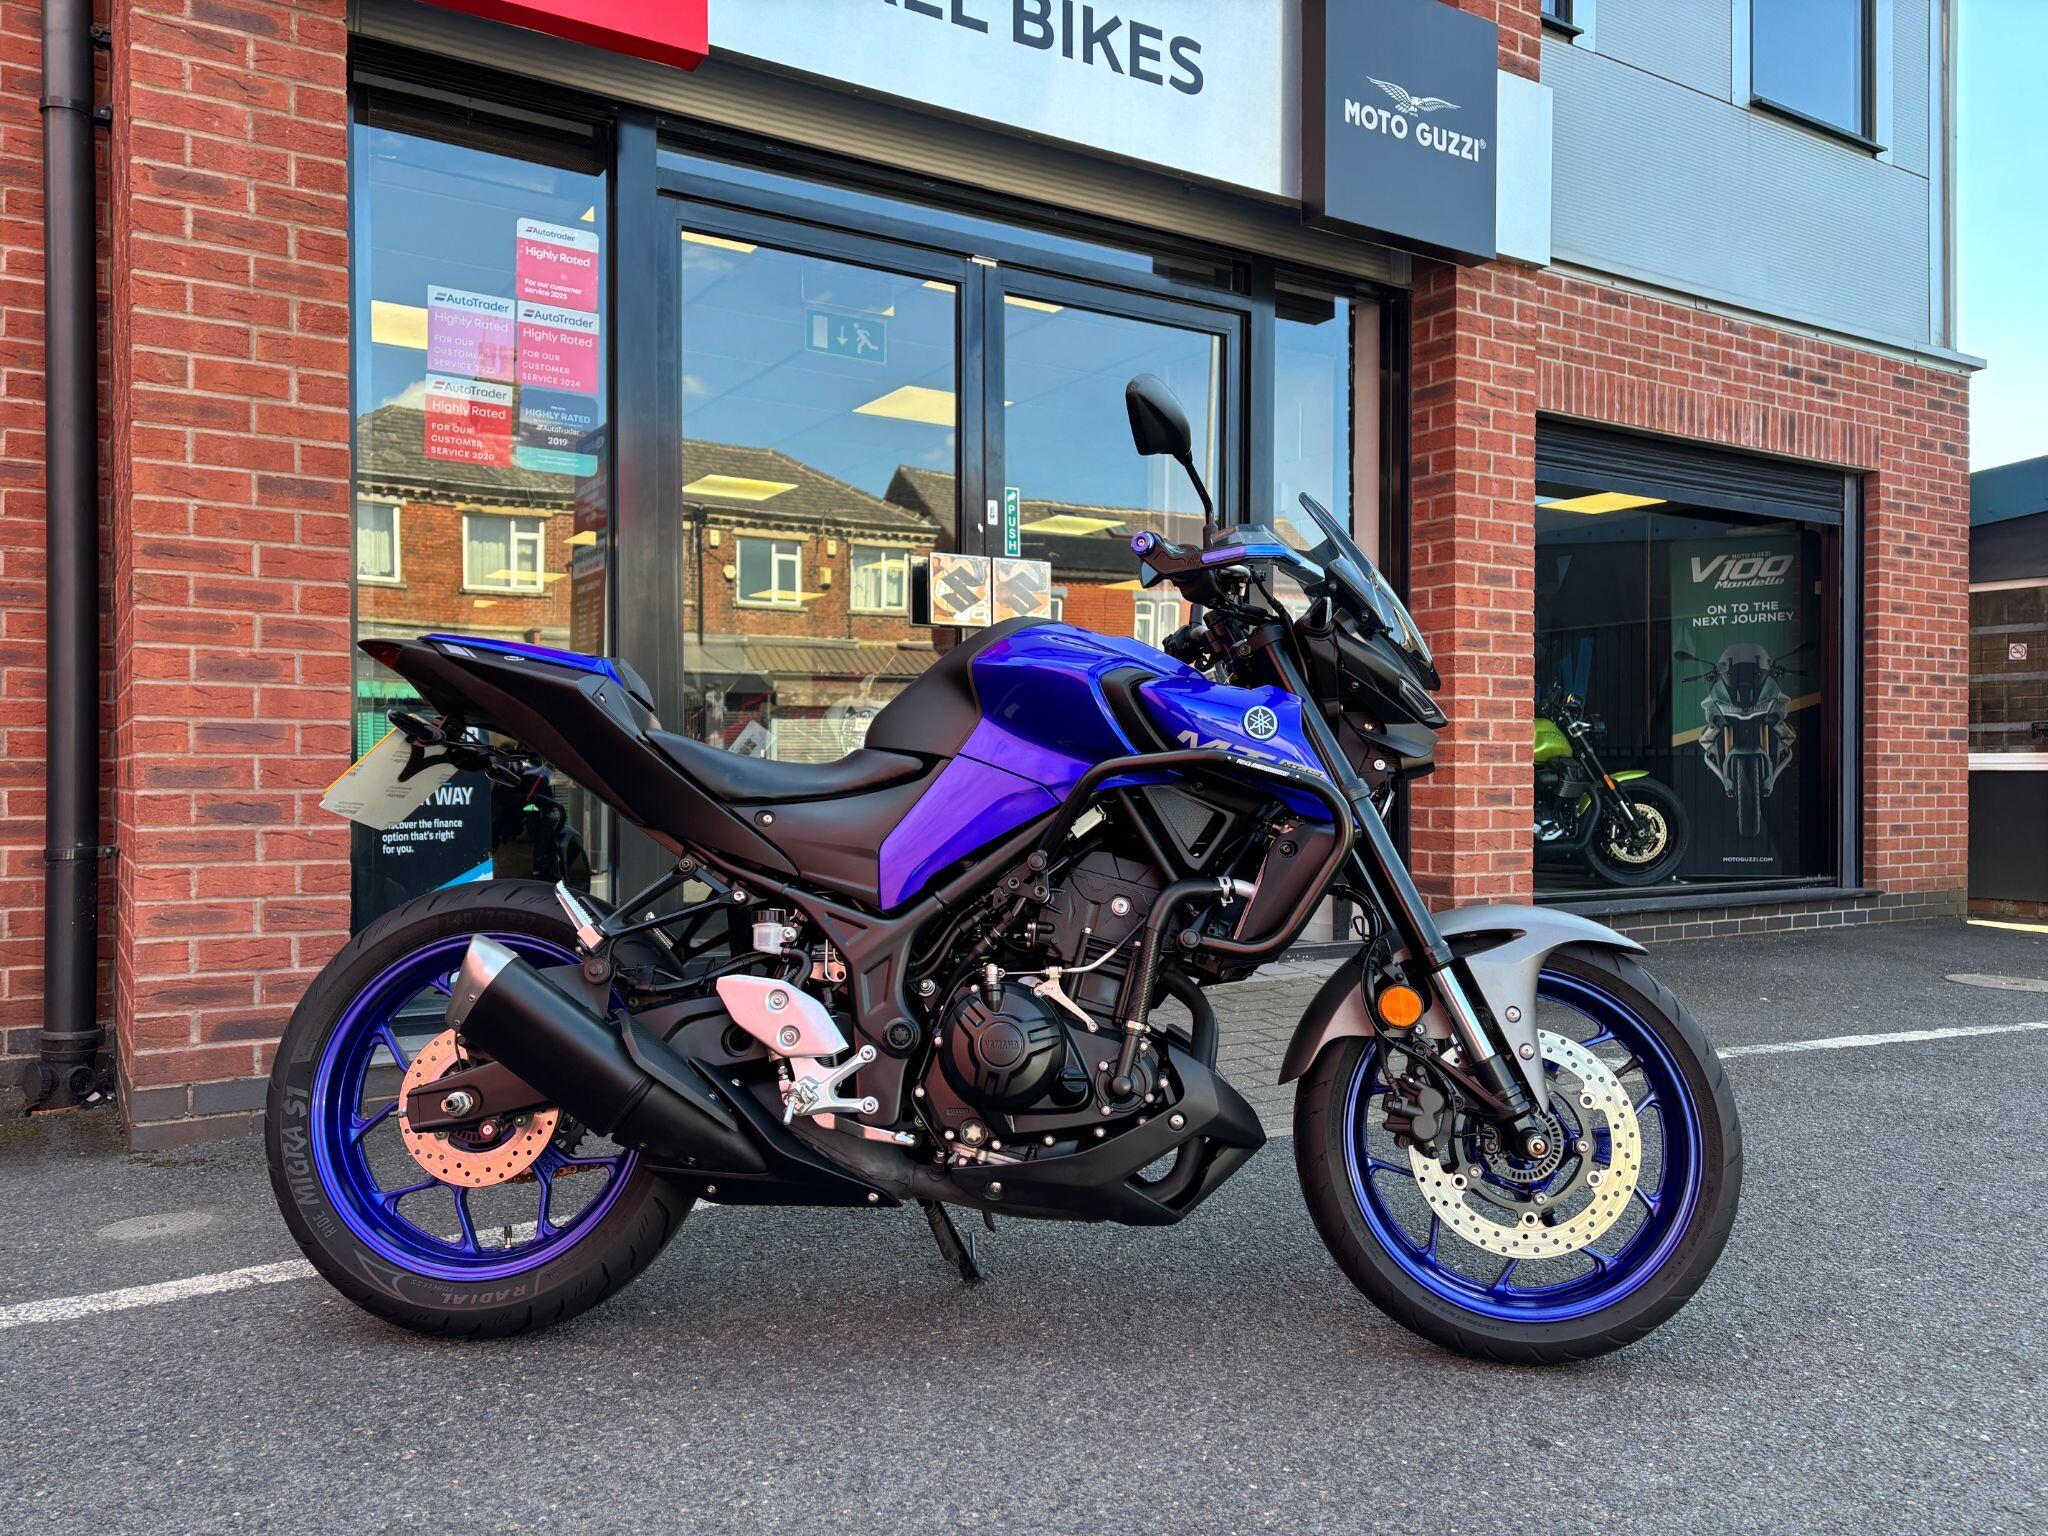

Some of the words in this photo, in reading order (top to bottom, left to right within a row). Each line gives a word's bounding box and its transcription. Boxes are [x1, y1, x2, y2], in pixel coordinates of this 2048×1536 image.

[1012, 0, 1204, 95] BIKES
[1344, 98, 1408, 139] MOTO
[533, 227, 576, 242] Autotrader
[525, 246, 558, 263] Highly
[560, 253, 591, 267] Rated
[524, 278, 537, 287] For
[537, 281, 550, 290] our
[550, 284, 582, 296] customer
[524, 287, 550, 298] service
[446, 294, 510, 313] AutoTrader
[434, 311, 472, 329] Highly
[474, 318, 509, 333] Rated
[534, 310, 594, 329] AutoTrader
[434, 334, 452, 344] FOR
[454, 337, 474, 346] OUR
[523, 327, 558, 344] Highly
[560, 333, 593, 348] Rated
[433, 347, 485, 361] CUSTOMER
[522, 349, 540, 359] FOR
[541, 352, 561, 362] OUR
[433, 358, 472, 371] SERVICE
[522, 361, 570, 375] CUSTOMER
[521, 372, 559, 384] SERVICE
[560, 378, 581, 388] 2024
[444, 383, 508, 400] AutoTrader
[432, 399, 470, 417] Highly
[471, 405, 506, 420] Rated
[525, 407, 560, 420] HIGHLY
[561, 412, 591, 424] RATED
[431, 422, 450, 432] FOR
[452, 425, 473, 435] OUR
[543, 424, 580, 436] AutoTrader
[430, 434, 484, 449] CUSTOMER
[547, 436, 568, 446] 2019
[430, 446, 470, 458] SERVICE
[472, 451, 495, 462] 2020
[1008, 504, 1016, 551] PUSH
[1690, 554, 1794, 583] V100
[1714, 576, 1785, 590] Mandello
[1706, 604, 1727, 615] ON
[1730, 603, 1749, 613] TO
[1753, 601, 1779, 611] THE
[1692, 615, 1727, 628] NEXT
[1730, 611, 1795, 625] JOURNEY
[434, 786, 473, 806] WAY
[418, 818, 433, 829] the
[433, 818, 463, 828] finance
[382, 831, 409, 844] option
[410, 830, 434, 841] that's
[435, 829, 455, 842] right
[382, 844, 395, 854] for
[396, 845, 414, 856] you.
[282, 1125, 321, 1206] MIGRA
[312, 1210, 338, 1240] RIDE
[441, 1284, 528, 1306] RADIAL
